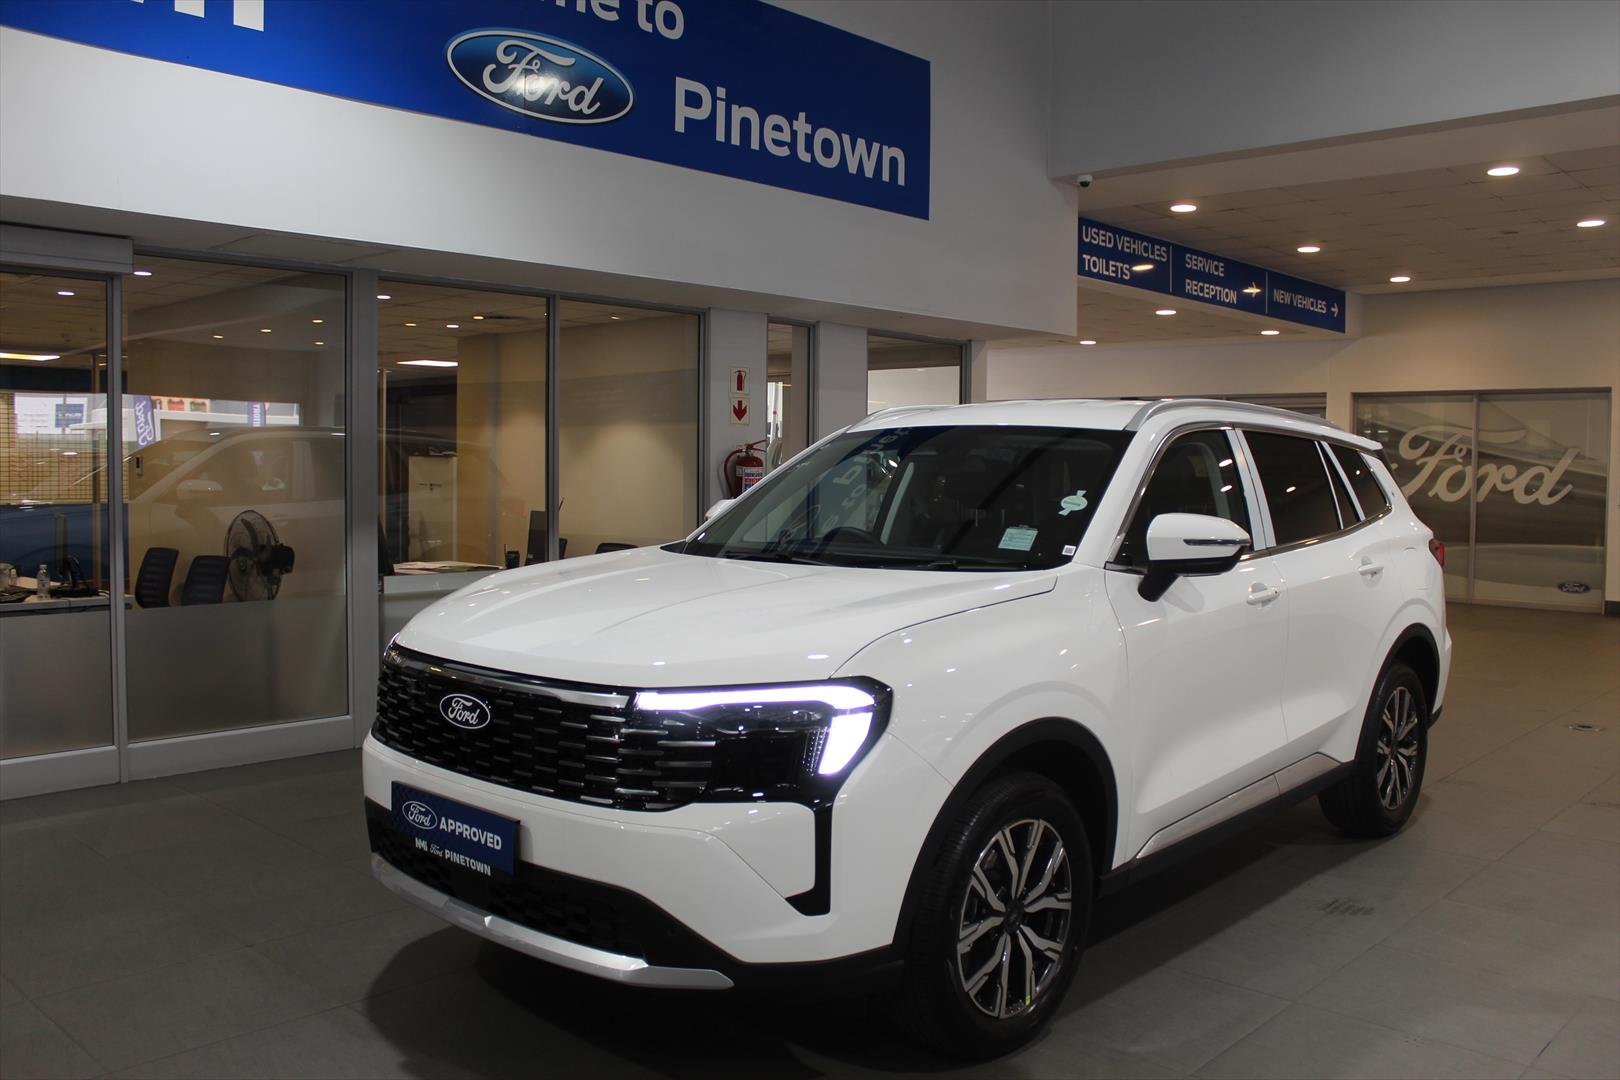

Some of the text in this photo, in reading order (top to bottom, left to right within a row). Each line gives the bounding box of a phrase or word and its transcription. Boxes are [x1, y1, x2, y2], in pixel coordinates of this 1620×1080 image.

[637, 0, 685, 40] to
[482, 39, 605, 115] Ford
[674, 76, 906, 187] Pinetown
[1082, 225, 1168, 262] USED VEHICLES
[1082, 254, 1131, 280] TOILETS
[1184, 253, 1225, 277] SERVICE
[1185, 278, 1237, 305] RECEPTION
[1273, 289, 1327, 314] NEW VEHICLES
[1391, 424, 1579, 506] Ford
[447, 697, 481, 725] Ford
[408, 803, 502, 850] Ford APPROVED
[429, 843, 443, 857] Ford
[444, 849, 491, 876] PINETOWN
